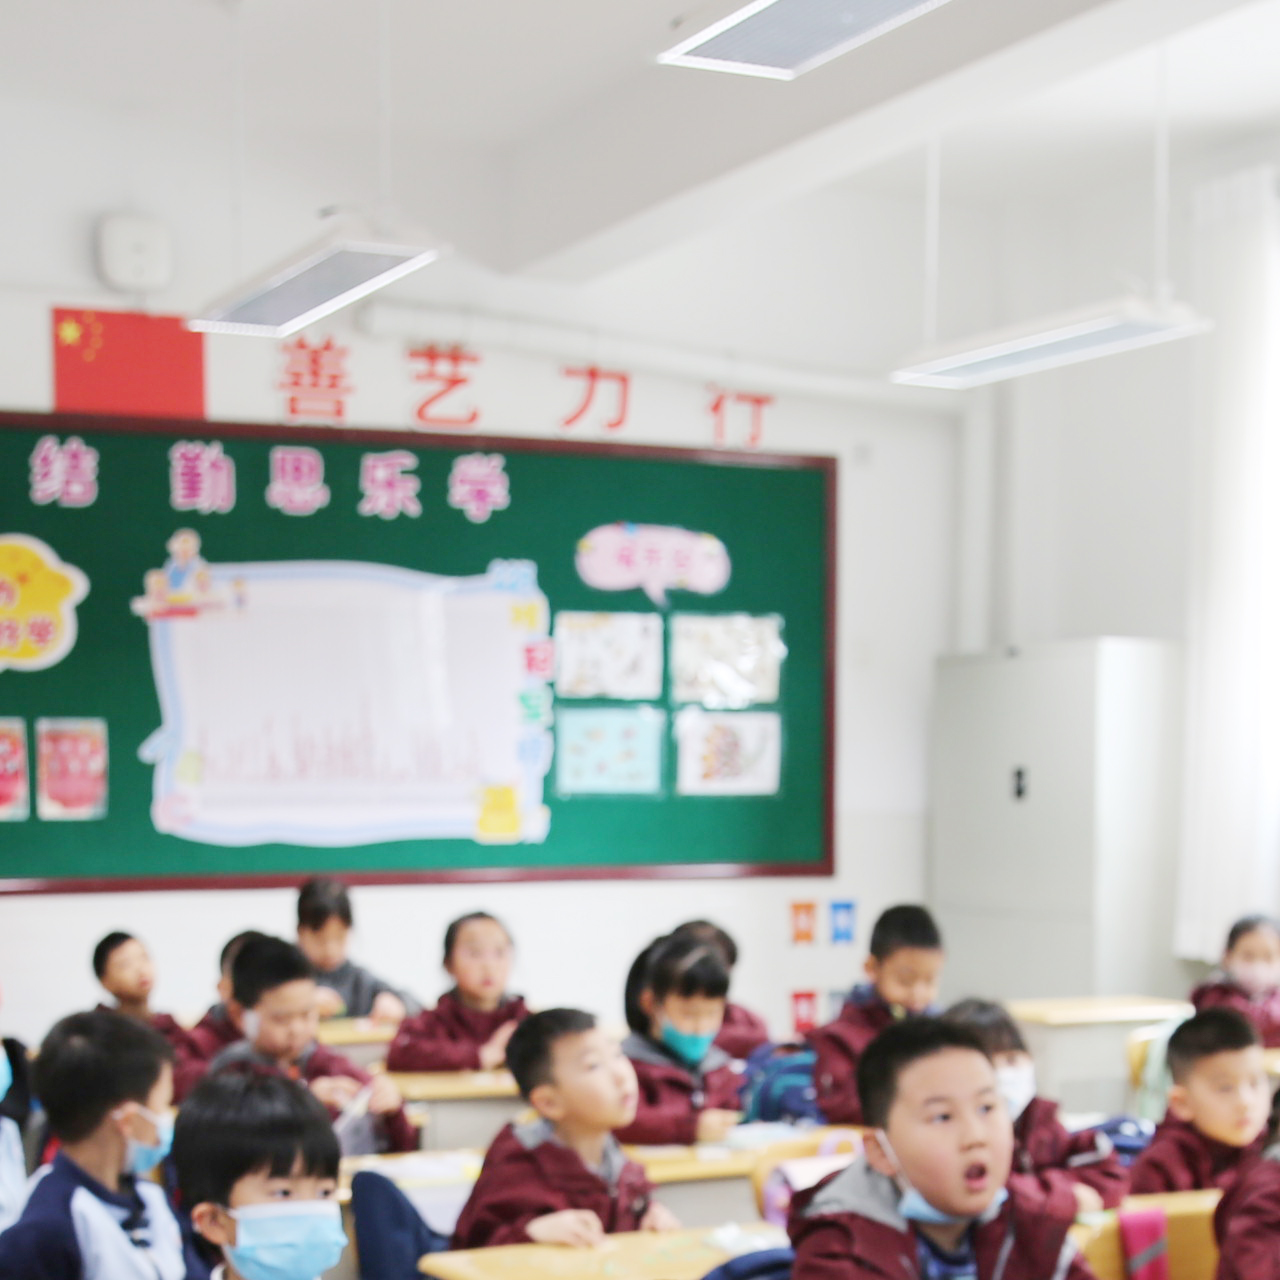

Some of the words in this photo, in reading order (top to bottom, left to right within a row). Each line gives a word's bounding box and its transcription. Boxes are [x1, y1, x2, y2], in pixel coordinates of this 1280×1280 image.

[277, 338, 775, 448] 善艺力行
[169, 439, 512, 522] 勤思乐学
